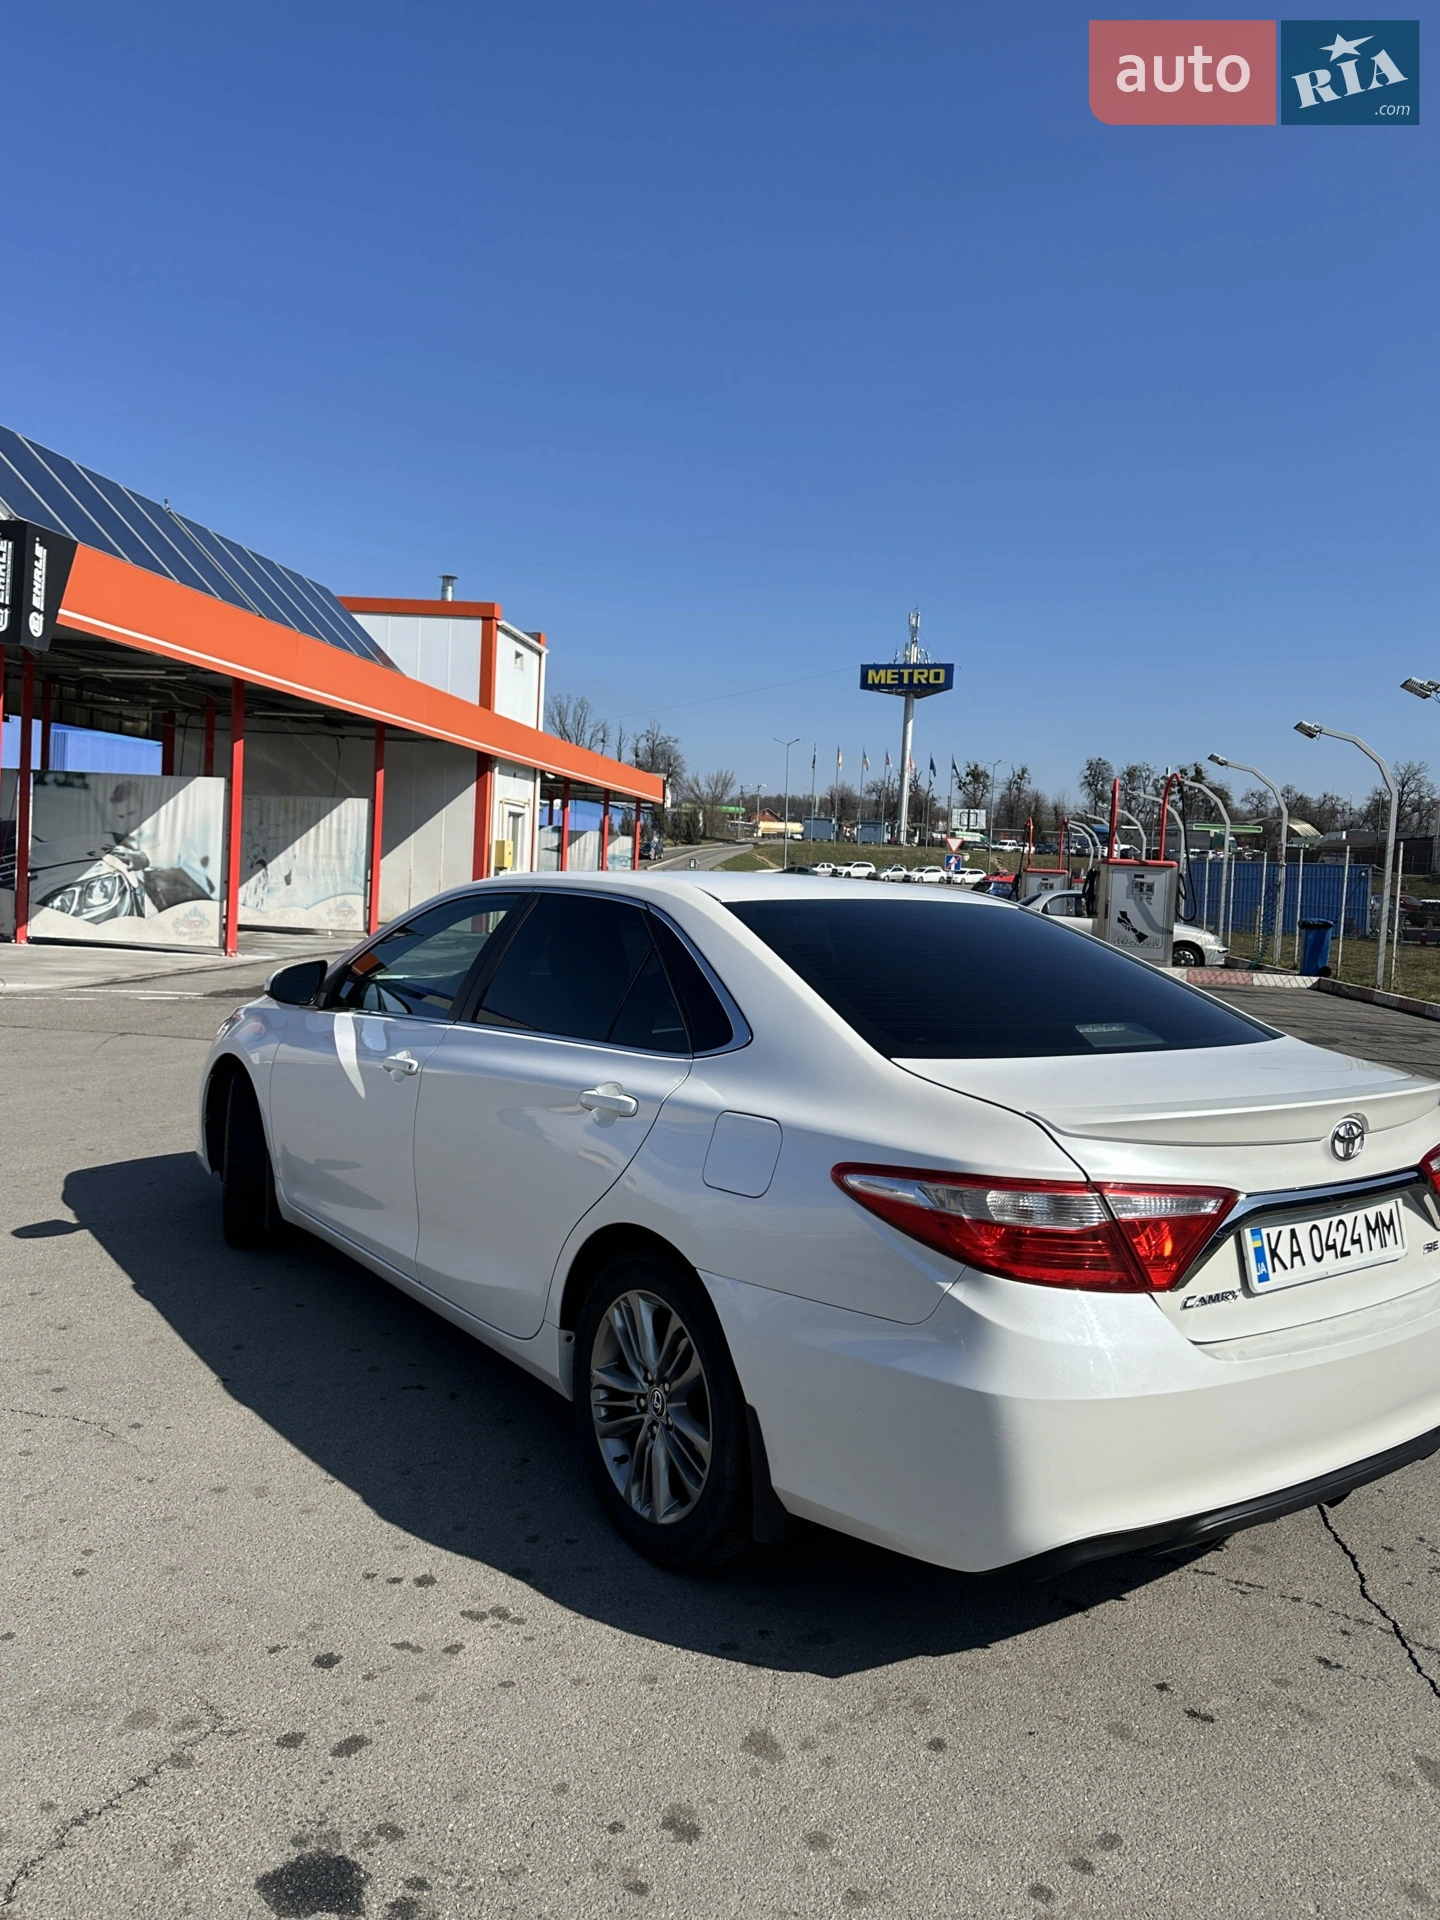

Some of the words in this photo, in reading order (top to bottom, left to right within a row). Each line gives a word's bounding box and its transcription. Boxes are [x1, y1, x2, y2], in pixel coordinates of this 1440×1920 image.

[32, 543, 44, 611] EHRLE
[867, 668, 945, 684] METRO
[1266, 1228, 1306, 1274] KA
[1309, 1215, 1364, 1263] 0424
[1364, 1208, 1398, 1251] MM
[1180, 1289, 1240, 1311] CAMRY
